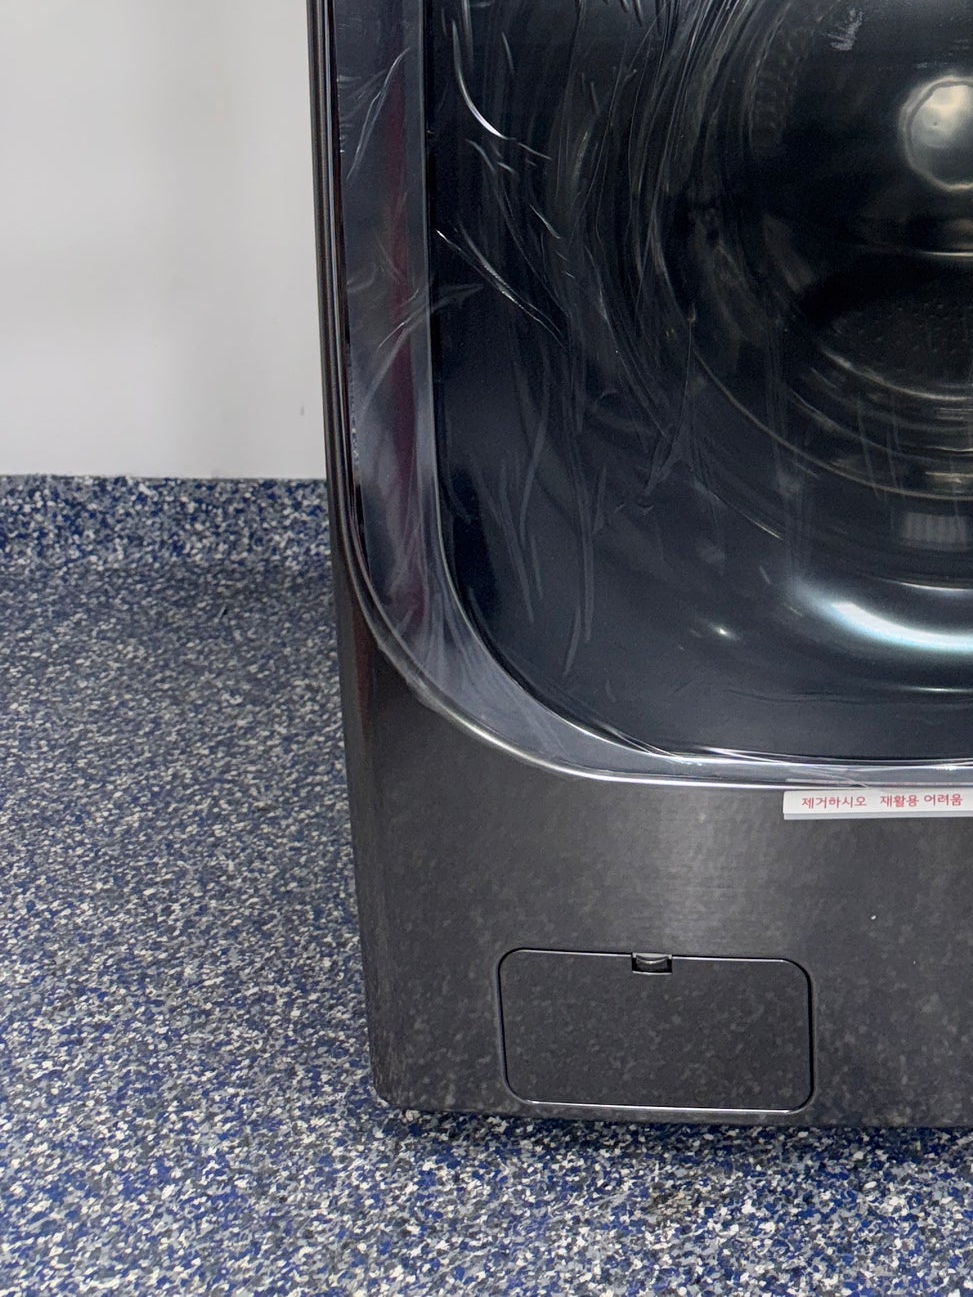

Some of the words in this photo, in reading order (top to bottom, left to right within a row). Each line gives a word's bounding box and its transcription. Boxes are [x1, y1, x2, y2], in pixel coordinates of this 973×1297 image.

[801, 795, 867, 810] 제거하시오
[880, 793, 919, 809] 재활용
[923, 792, 963, 808] 어려움
